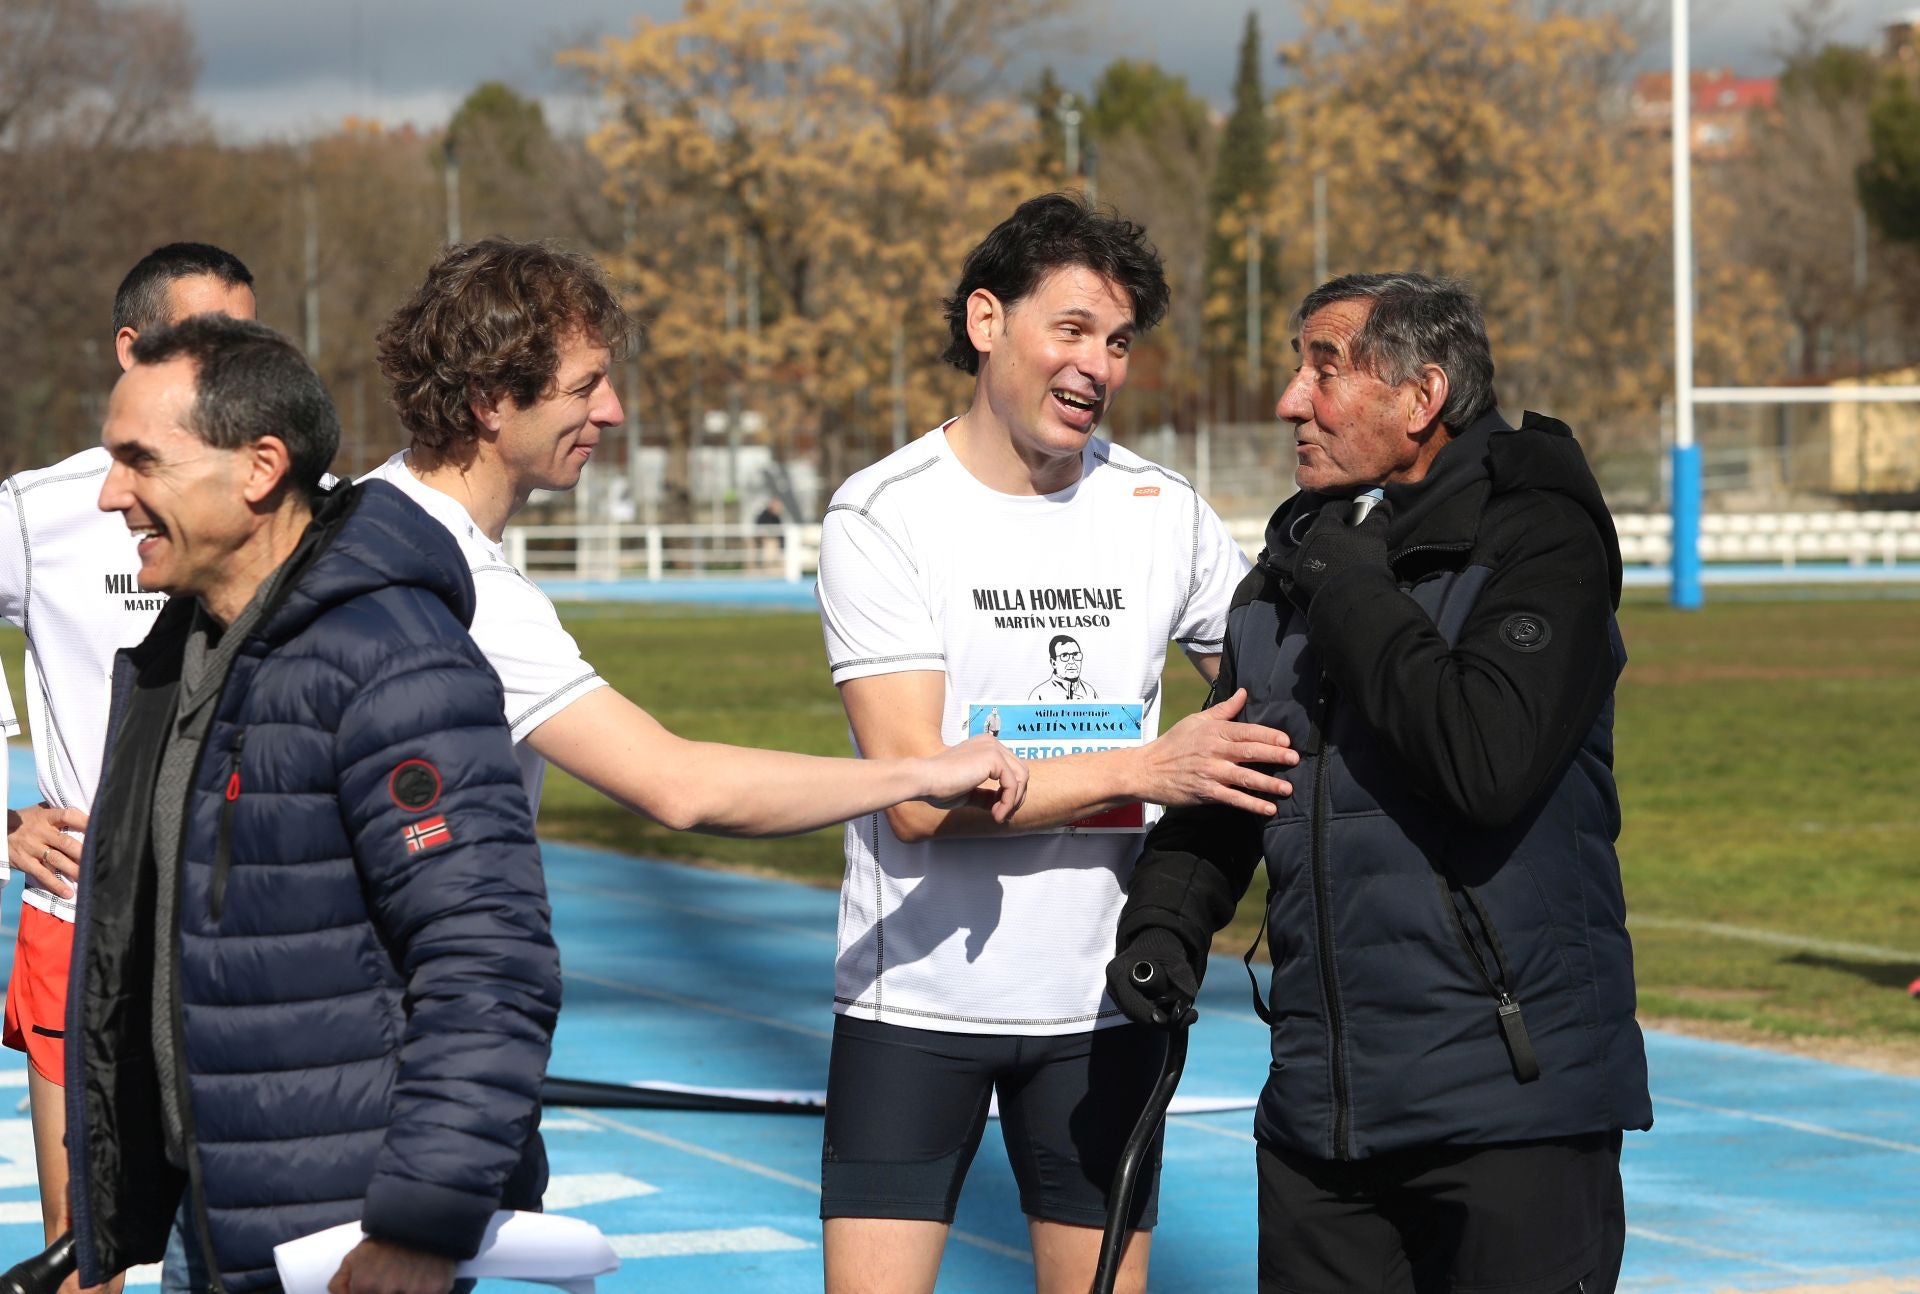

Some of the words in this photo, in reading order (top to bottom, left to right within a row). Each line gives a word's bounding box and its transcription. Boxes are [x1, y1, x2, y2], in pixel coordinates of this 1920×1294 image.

[105, 574, 160, 594] MILL
[973, 589, 1026, 611] MILLA
[1029, 587, 1126, 611] HOMENAJE
[994, 614, 1046, 629] MARTÍN
[1048, 614, 1111, 629] VELASCO
[1035, 709, 1059, 718] Milla
[1060, 709, 1111, 719] Homenaje
[1017, 720, 1067, 732] MARTÍN
[1071, 721, 1128, 732] VELASCO
